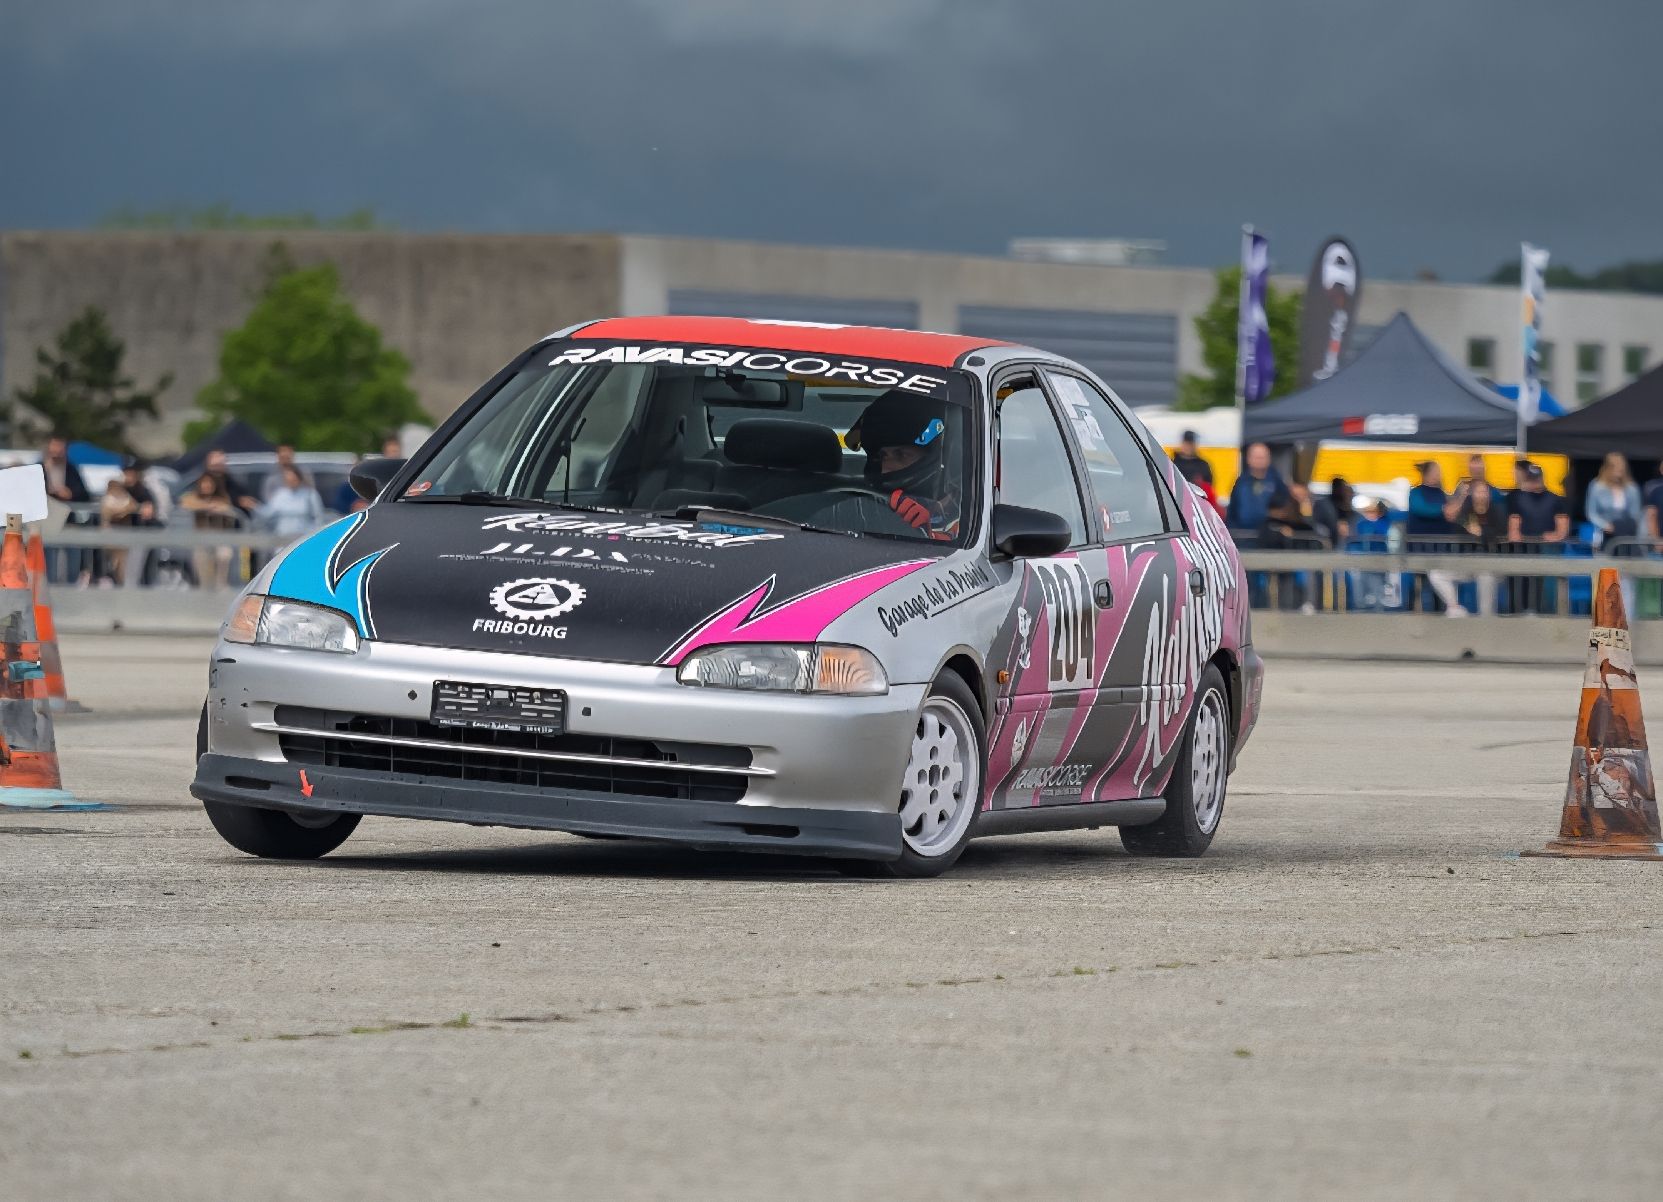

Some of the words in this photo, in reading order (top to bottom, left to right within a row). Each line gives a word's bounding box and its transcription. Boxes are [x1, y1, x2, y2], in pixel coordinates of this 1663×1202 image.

[547, 346, 947, 394] RAVASICORSE
[472, 617, 568, 639] FRIBOURG
[877, 593, 930, 638] Garage
[921, 582, 945, 607] de
[1036, 562, 1094, 682] 204
